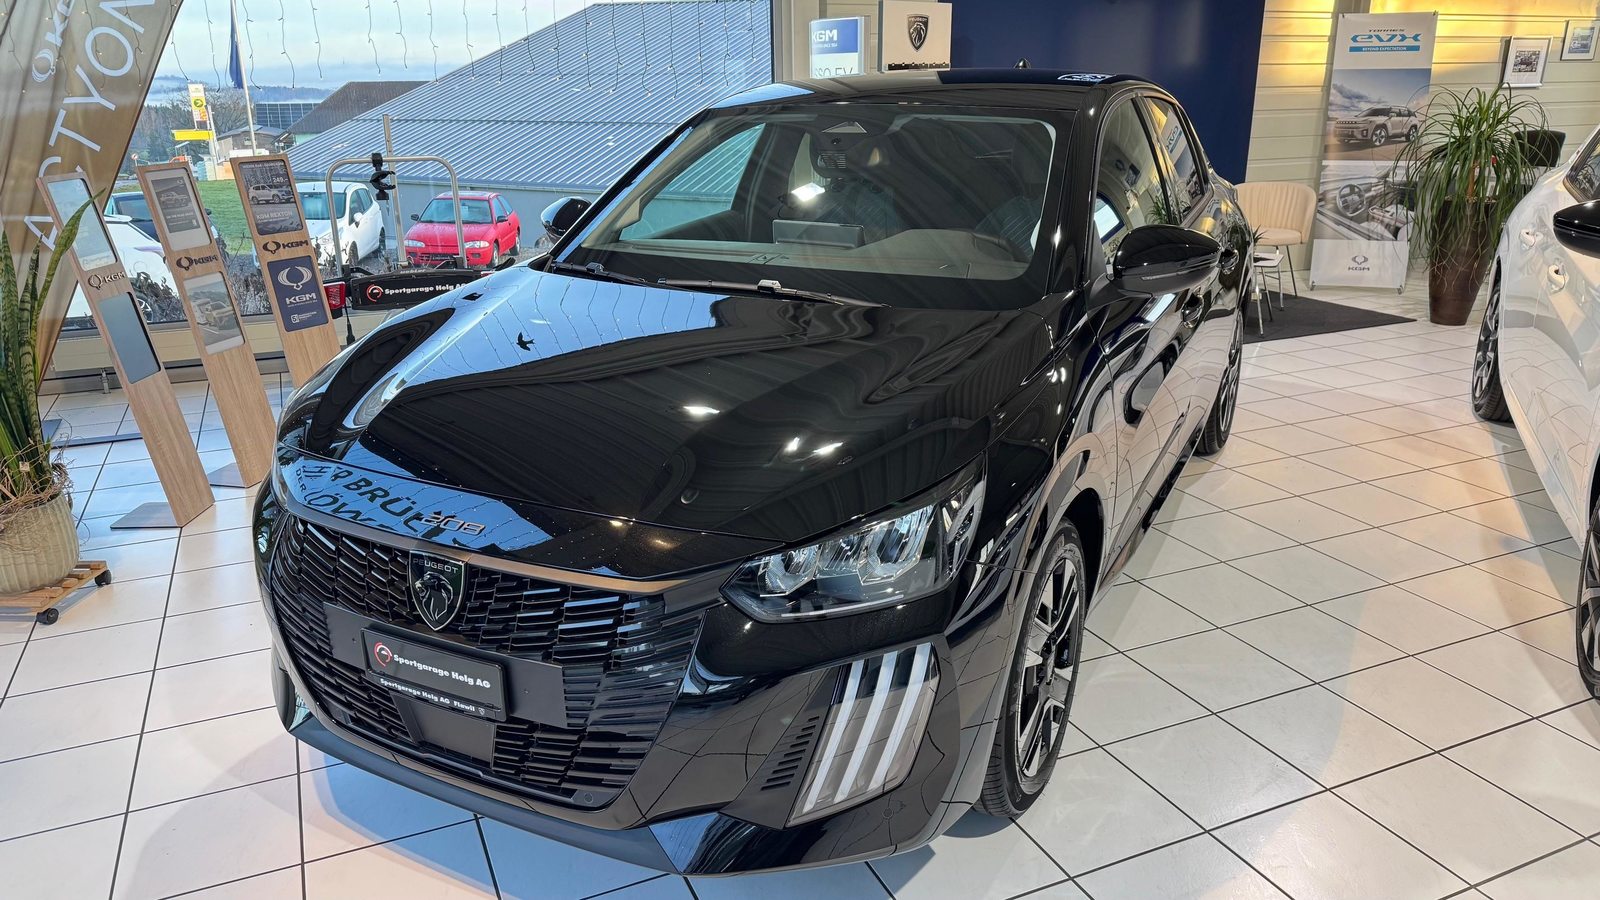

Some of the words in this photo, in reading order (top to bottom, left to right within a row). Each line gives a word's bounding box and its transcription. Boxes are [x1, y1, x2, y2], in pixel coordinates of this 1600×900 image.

[812, 29, 838, 43] KGM
[282, 240, 309, 249] KGM
[194, 255, 218, 265] KGM
[104, 271, 125, 284] KGM
[384, 286, 434, 295] Sportgarage
[435, 284, 454, 292] Helg
[285, 292, 317, 305] KGM
[421, 513, 486, 536] 208
[412, 558, 459, 574] PEUGEOT
[393, 654, 450, 677] Sportgarage
[451, 671, 475, 686] Helg
[475, 678, 491, 688] AG
[380, 678, 421, 695] Sportgarage
[421, 690, 439, 702] Helg
[439, 696, 451, 704] AG
